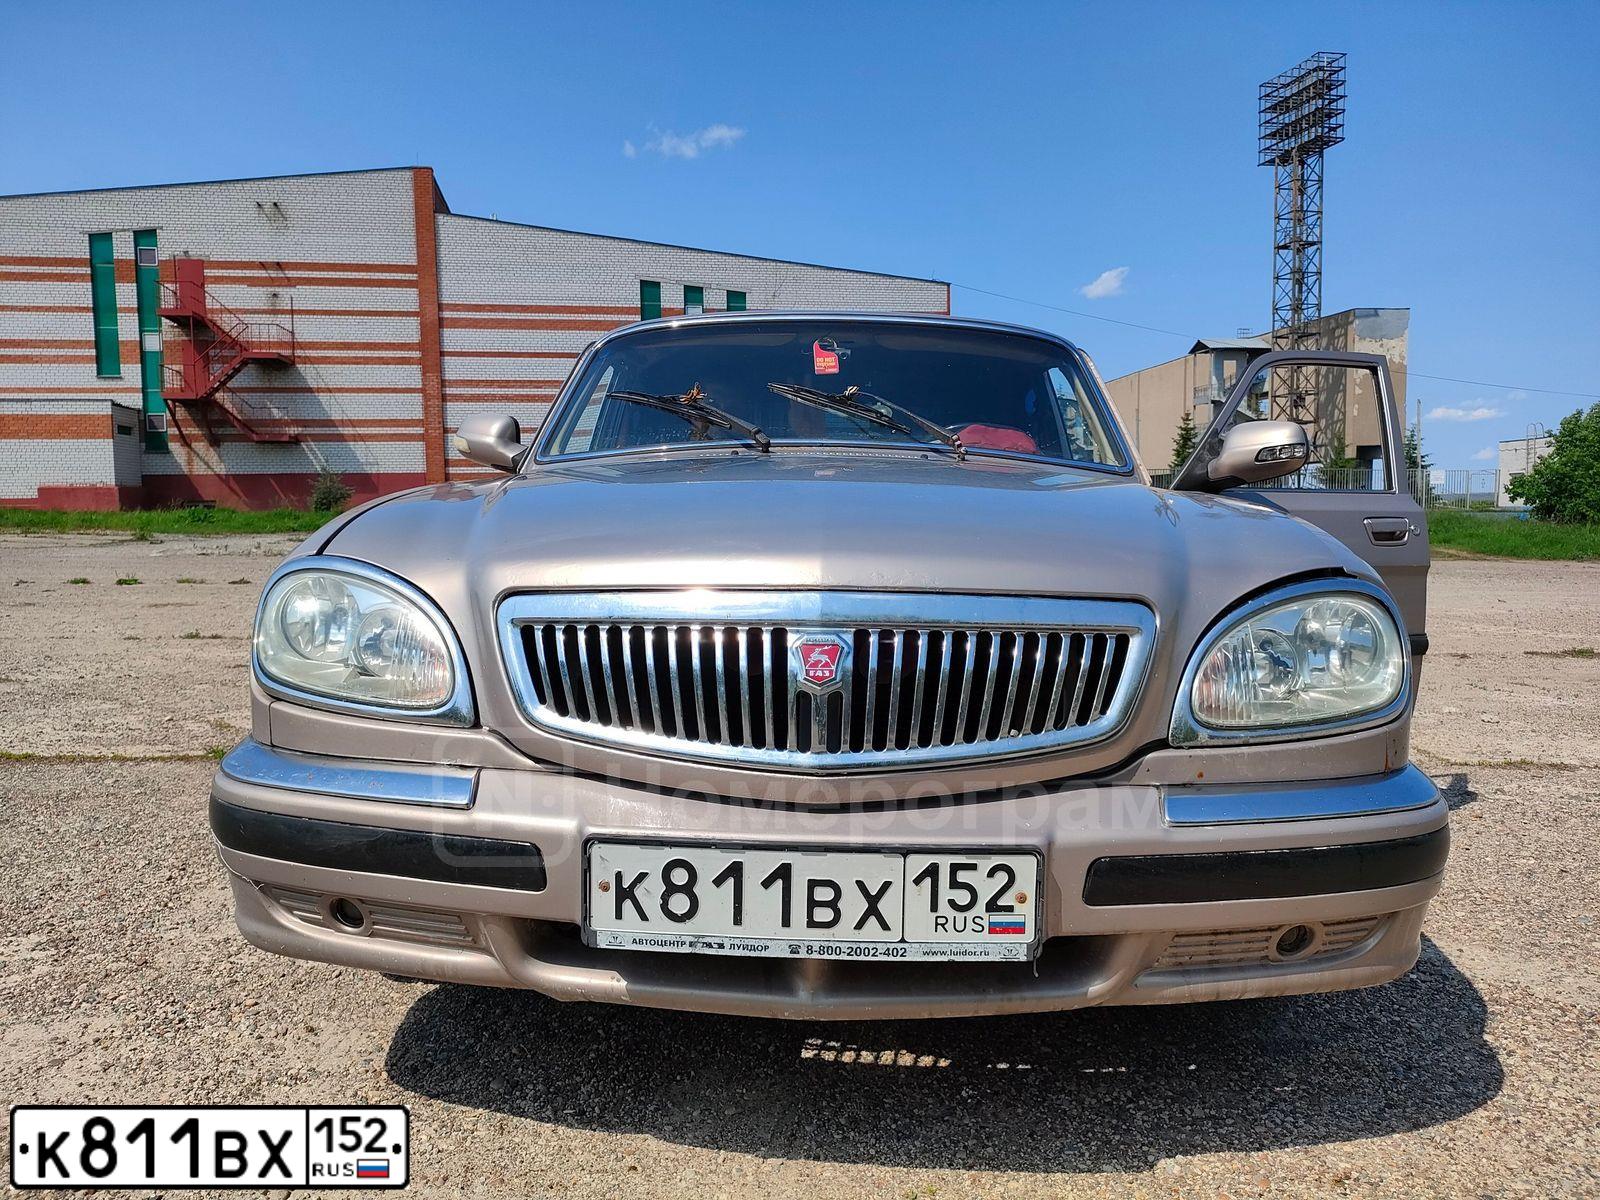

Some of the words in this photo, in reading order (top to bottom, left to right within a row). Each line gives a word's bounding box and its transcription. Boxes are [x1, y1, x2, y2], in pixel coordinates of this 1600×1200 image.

[911, 862, 1016, 914] 152
[933, 915, 985, 934] RUS
[631, 937, 687, 948] АВТОЦЕНТР
[728, 943, 770, 952] ЛУИДОР
[805, 944, 908, 958] 8-800-2002-402
[922, 949, 990, 957] www.luidor.ru
